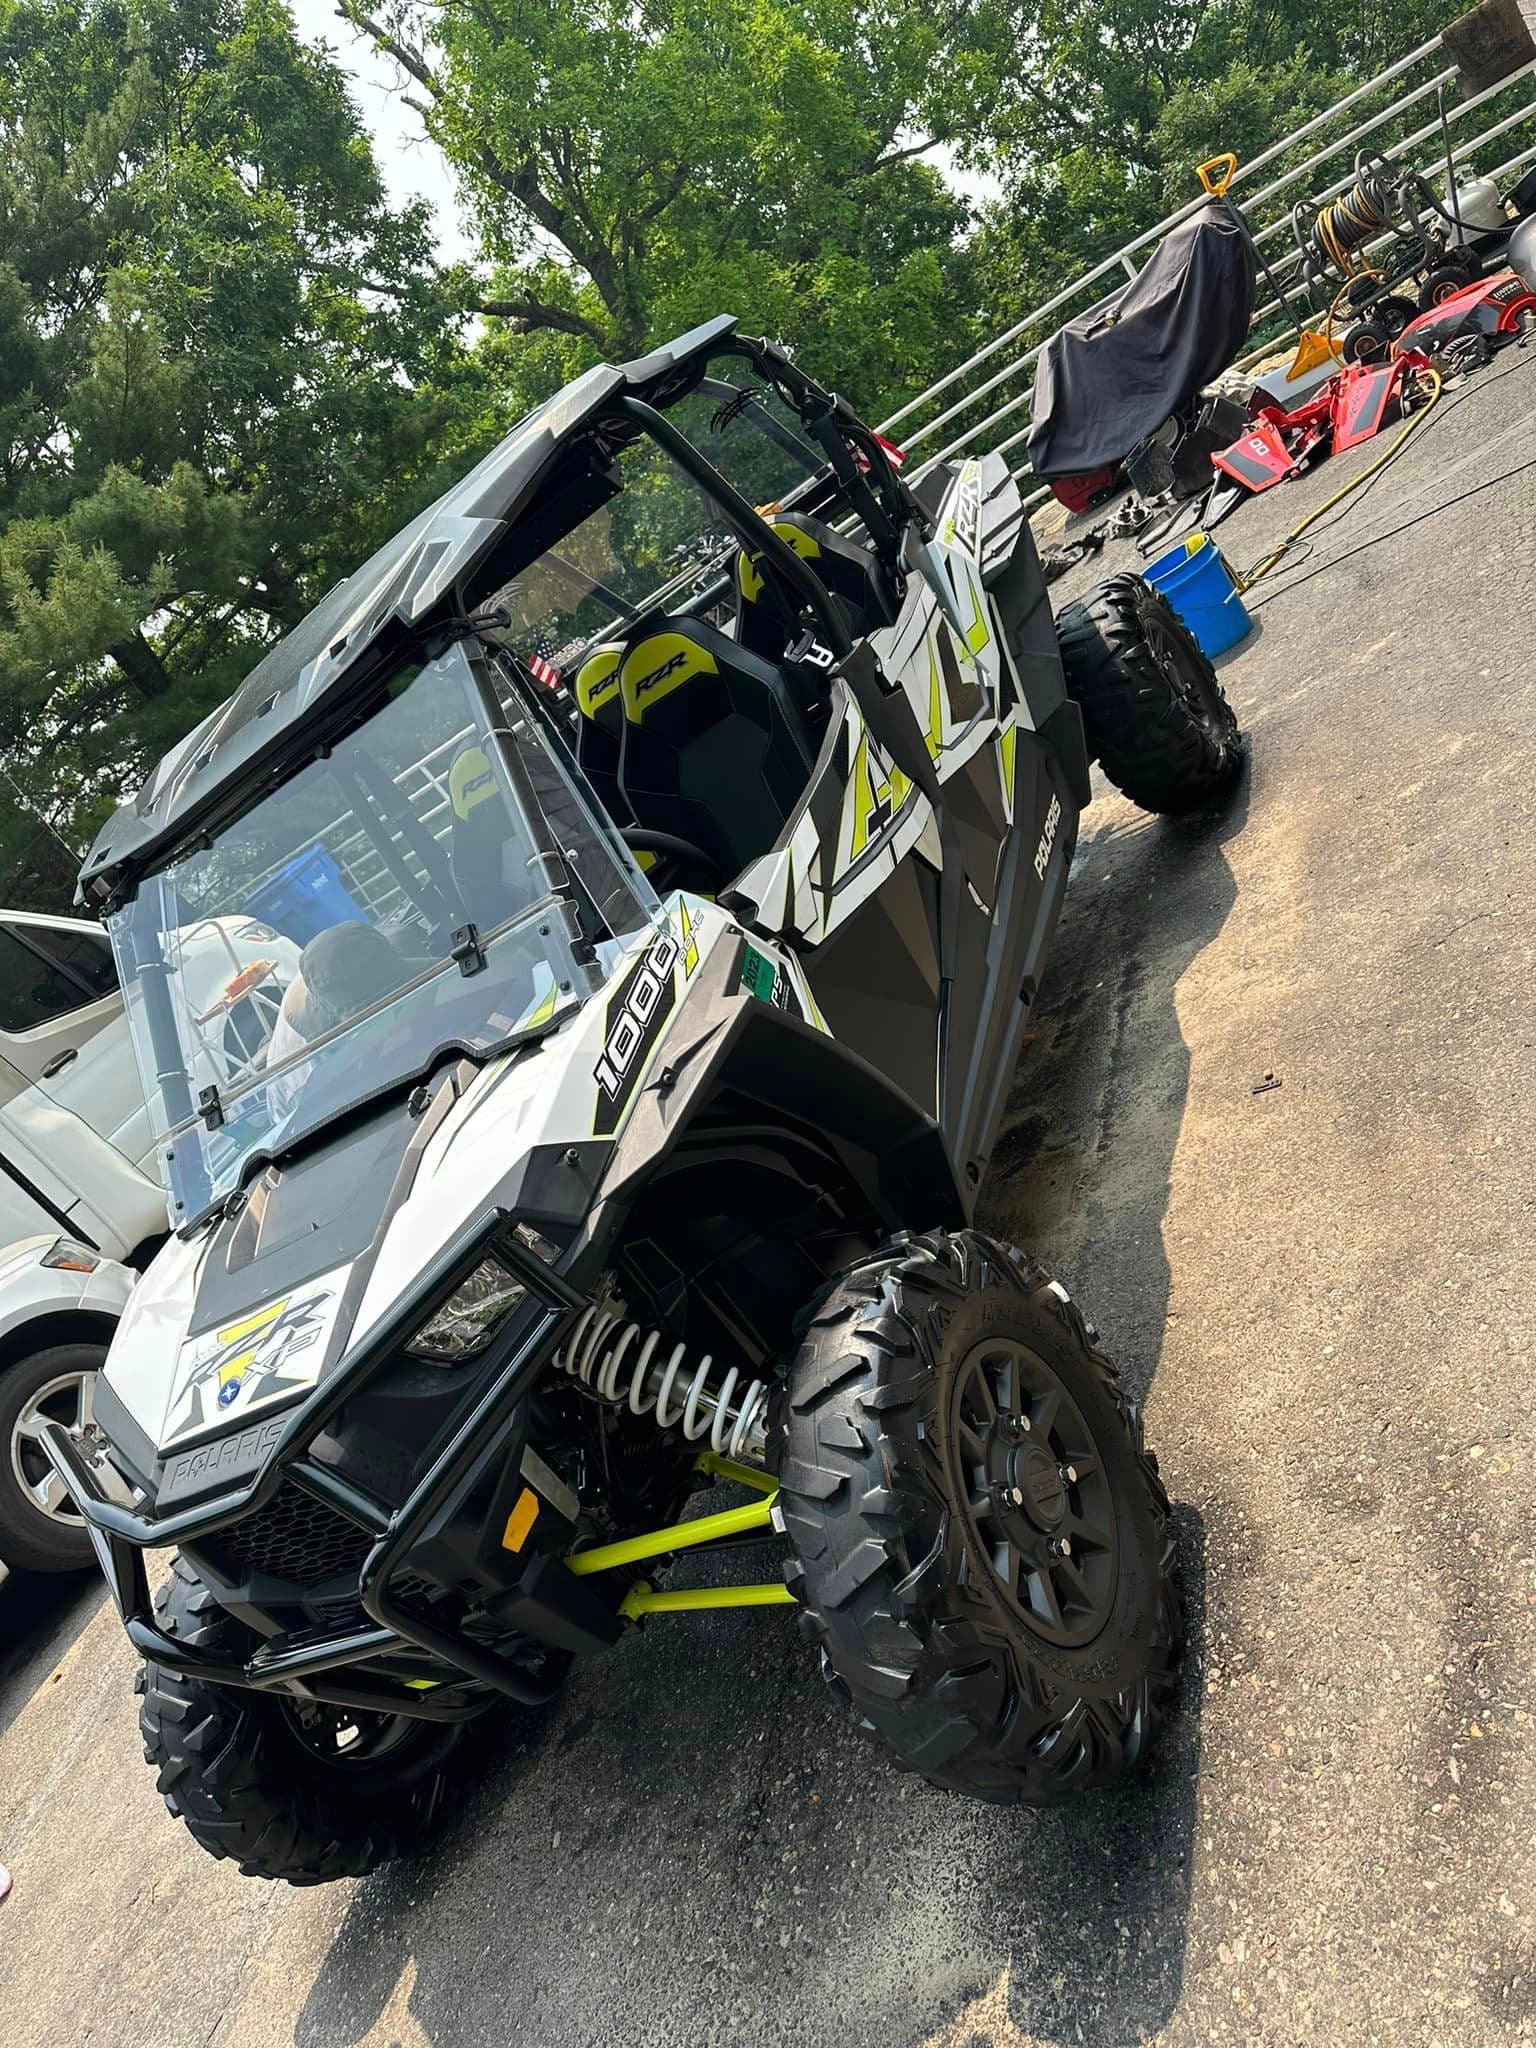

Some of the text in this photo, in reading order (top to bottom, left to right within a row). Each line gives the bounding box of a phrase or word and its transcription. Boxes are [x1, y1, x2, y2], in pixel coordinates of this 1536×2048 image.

[954, 481, 979, 556] RZR
[635, 651, 689, 701] RZR
[462, 770, 491, 801] RZ
[1034, 792, 1061, 881] POLARIS
[746, 950, 761, 991] 2023
[593, 931, 680, 1102] 1000
[169, 1419, 287, 1492] POLARIS
